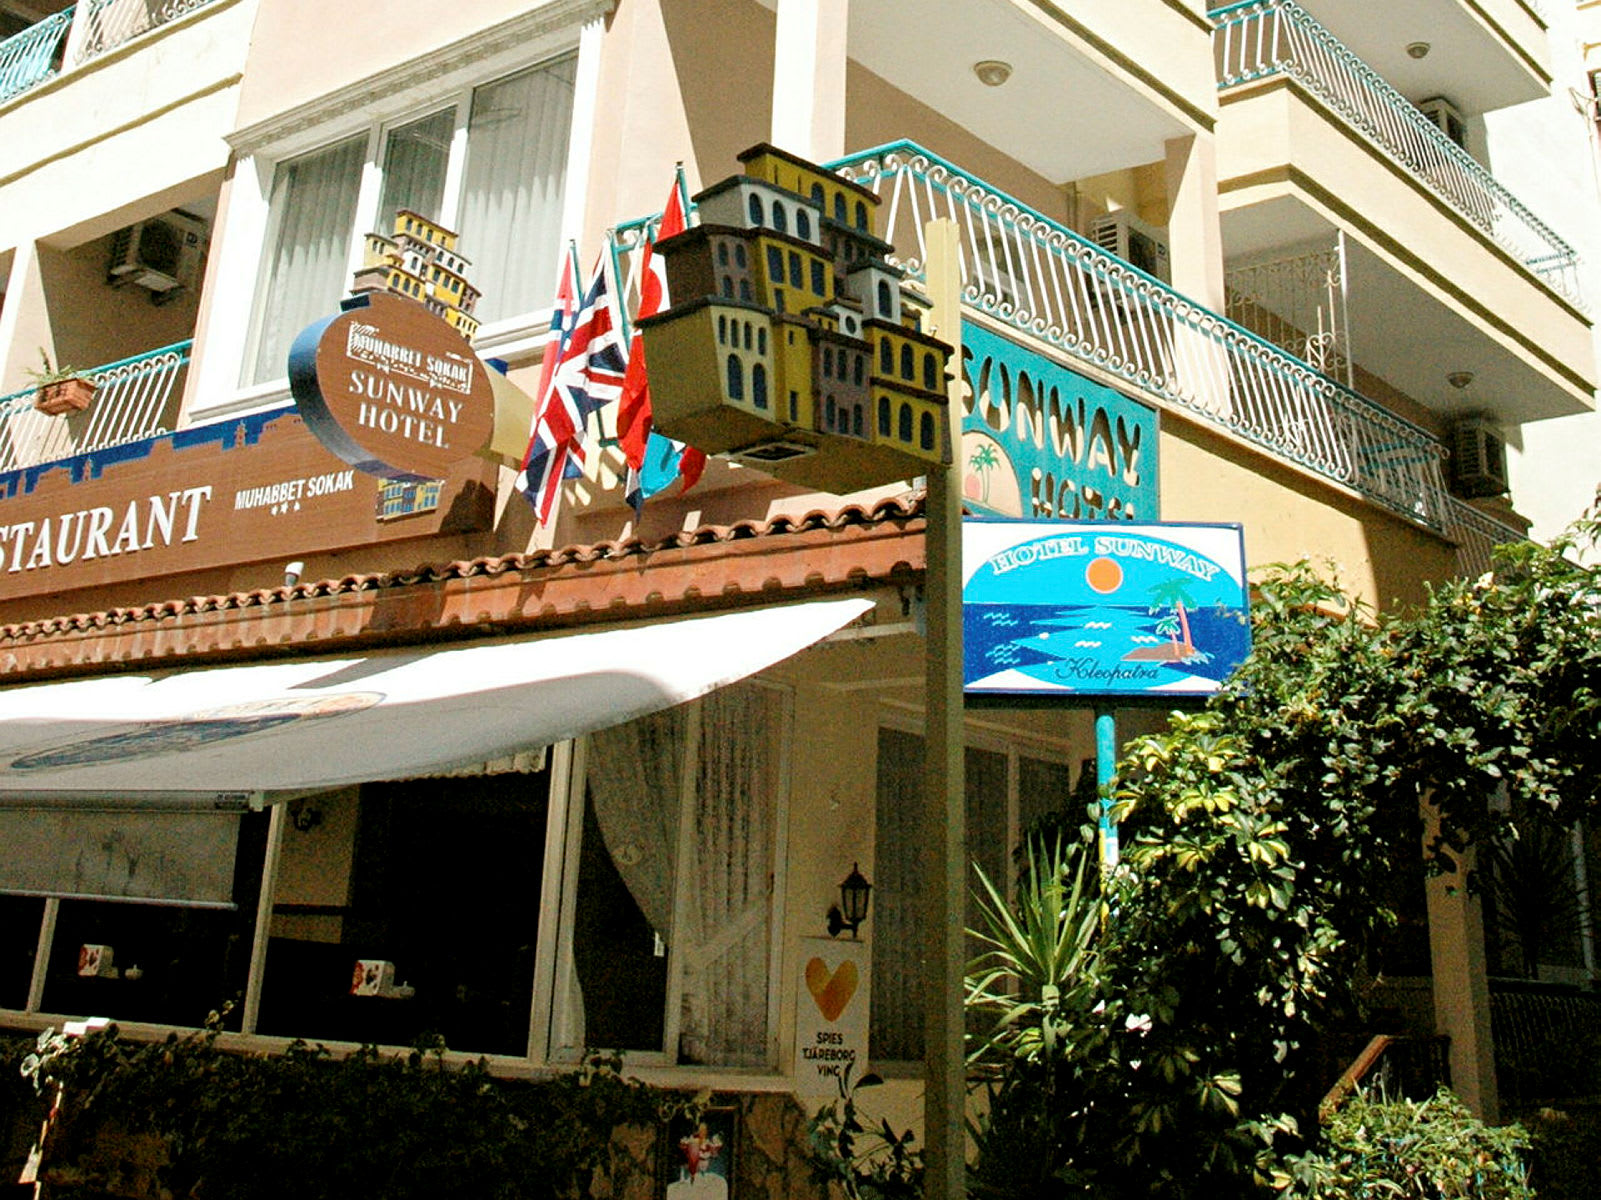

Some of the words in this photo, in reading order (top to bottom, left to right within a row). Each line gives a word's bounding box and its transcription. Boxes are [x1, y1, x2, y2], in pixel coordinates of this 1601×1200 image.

[426, 355, 468, 381] SOKAK
[348, 370, 462, 424] SUNWAY
[358, 402, 449, 449] HOTEL
[234, 479, 306, 510] MUHABBET
[307, 470, 354, 499] SOKAK
[988, 537, 1090, 576] HOTEL
[1094, 536, 1221, 582] SUNWAY
[1055, 657, 1160, 686] Kleopatra
[816, 1031, 844, 1045] SPIES
